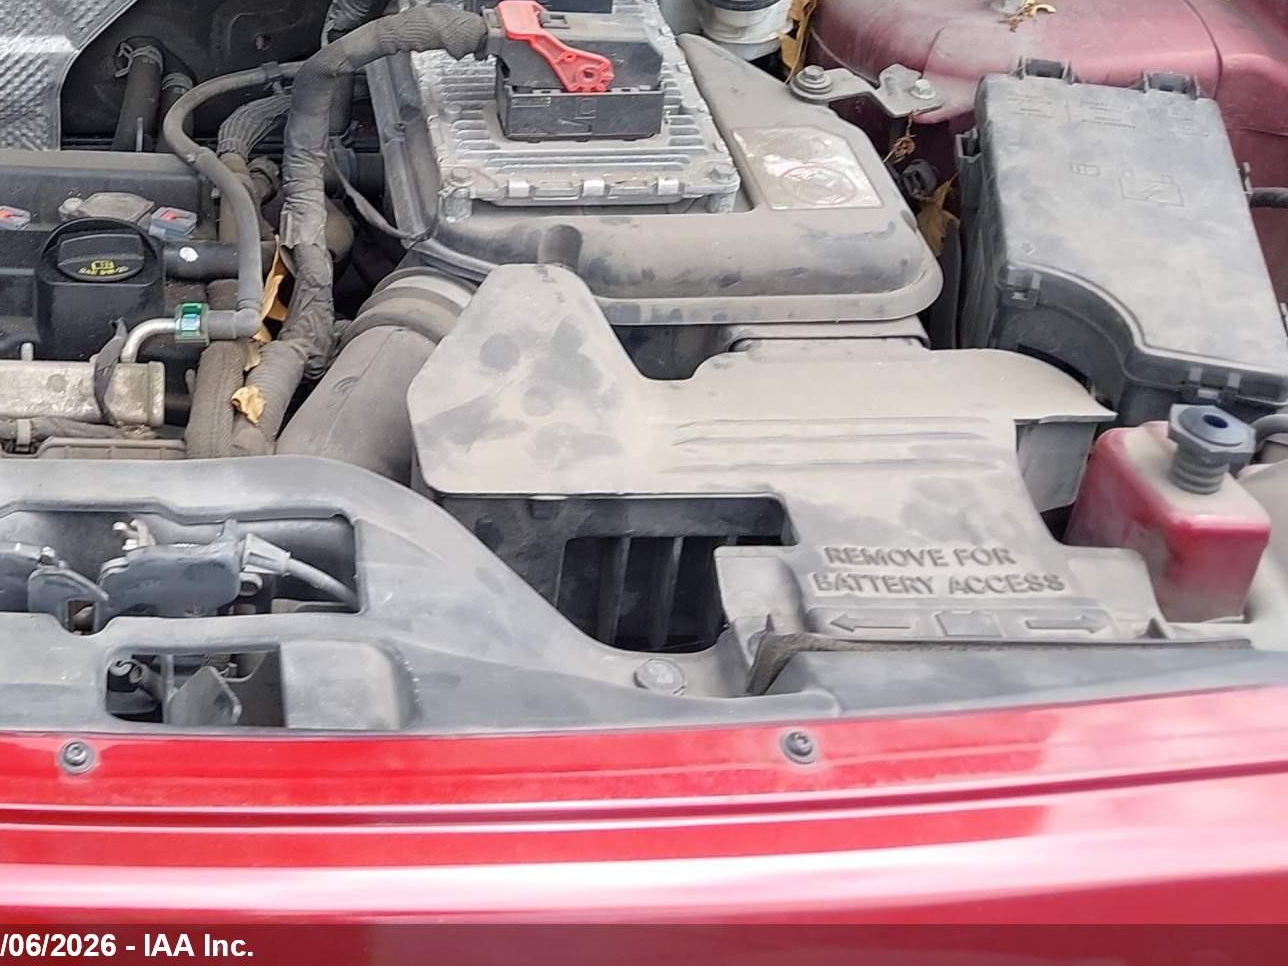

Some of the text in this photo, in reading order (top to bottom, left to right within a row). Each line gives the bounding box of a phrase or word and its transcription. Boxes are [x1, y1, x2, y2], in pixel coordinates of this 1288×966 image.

[823, 546, 1017, 567] REMOVE FOR
[812, 571, 1066, 595] BATTERY ACCESS
